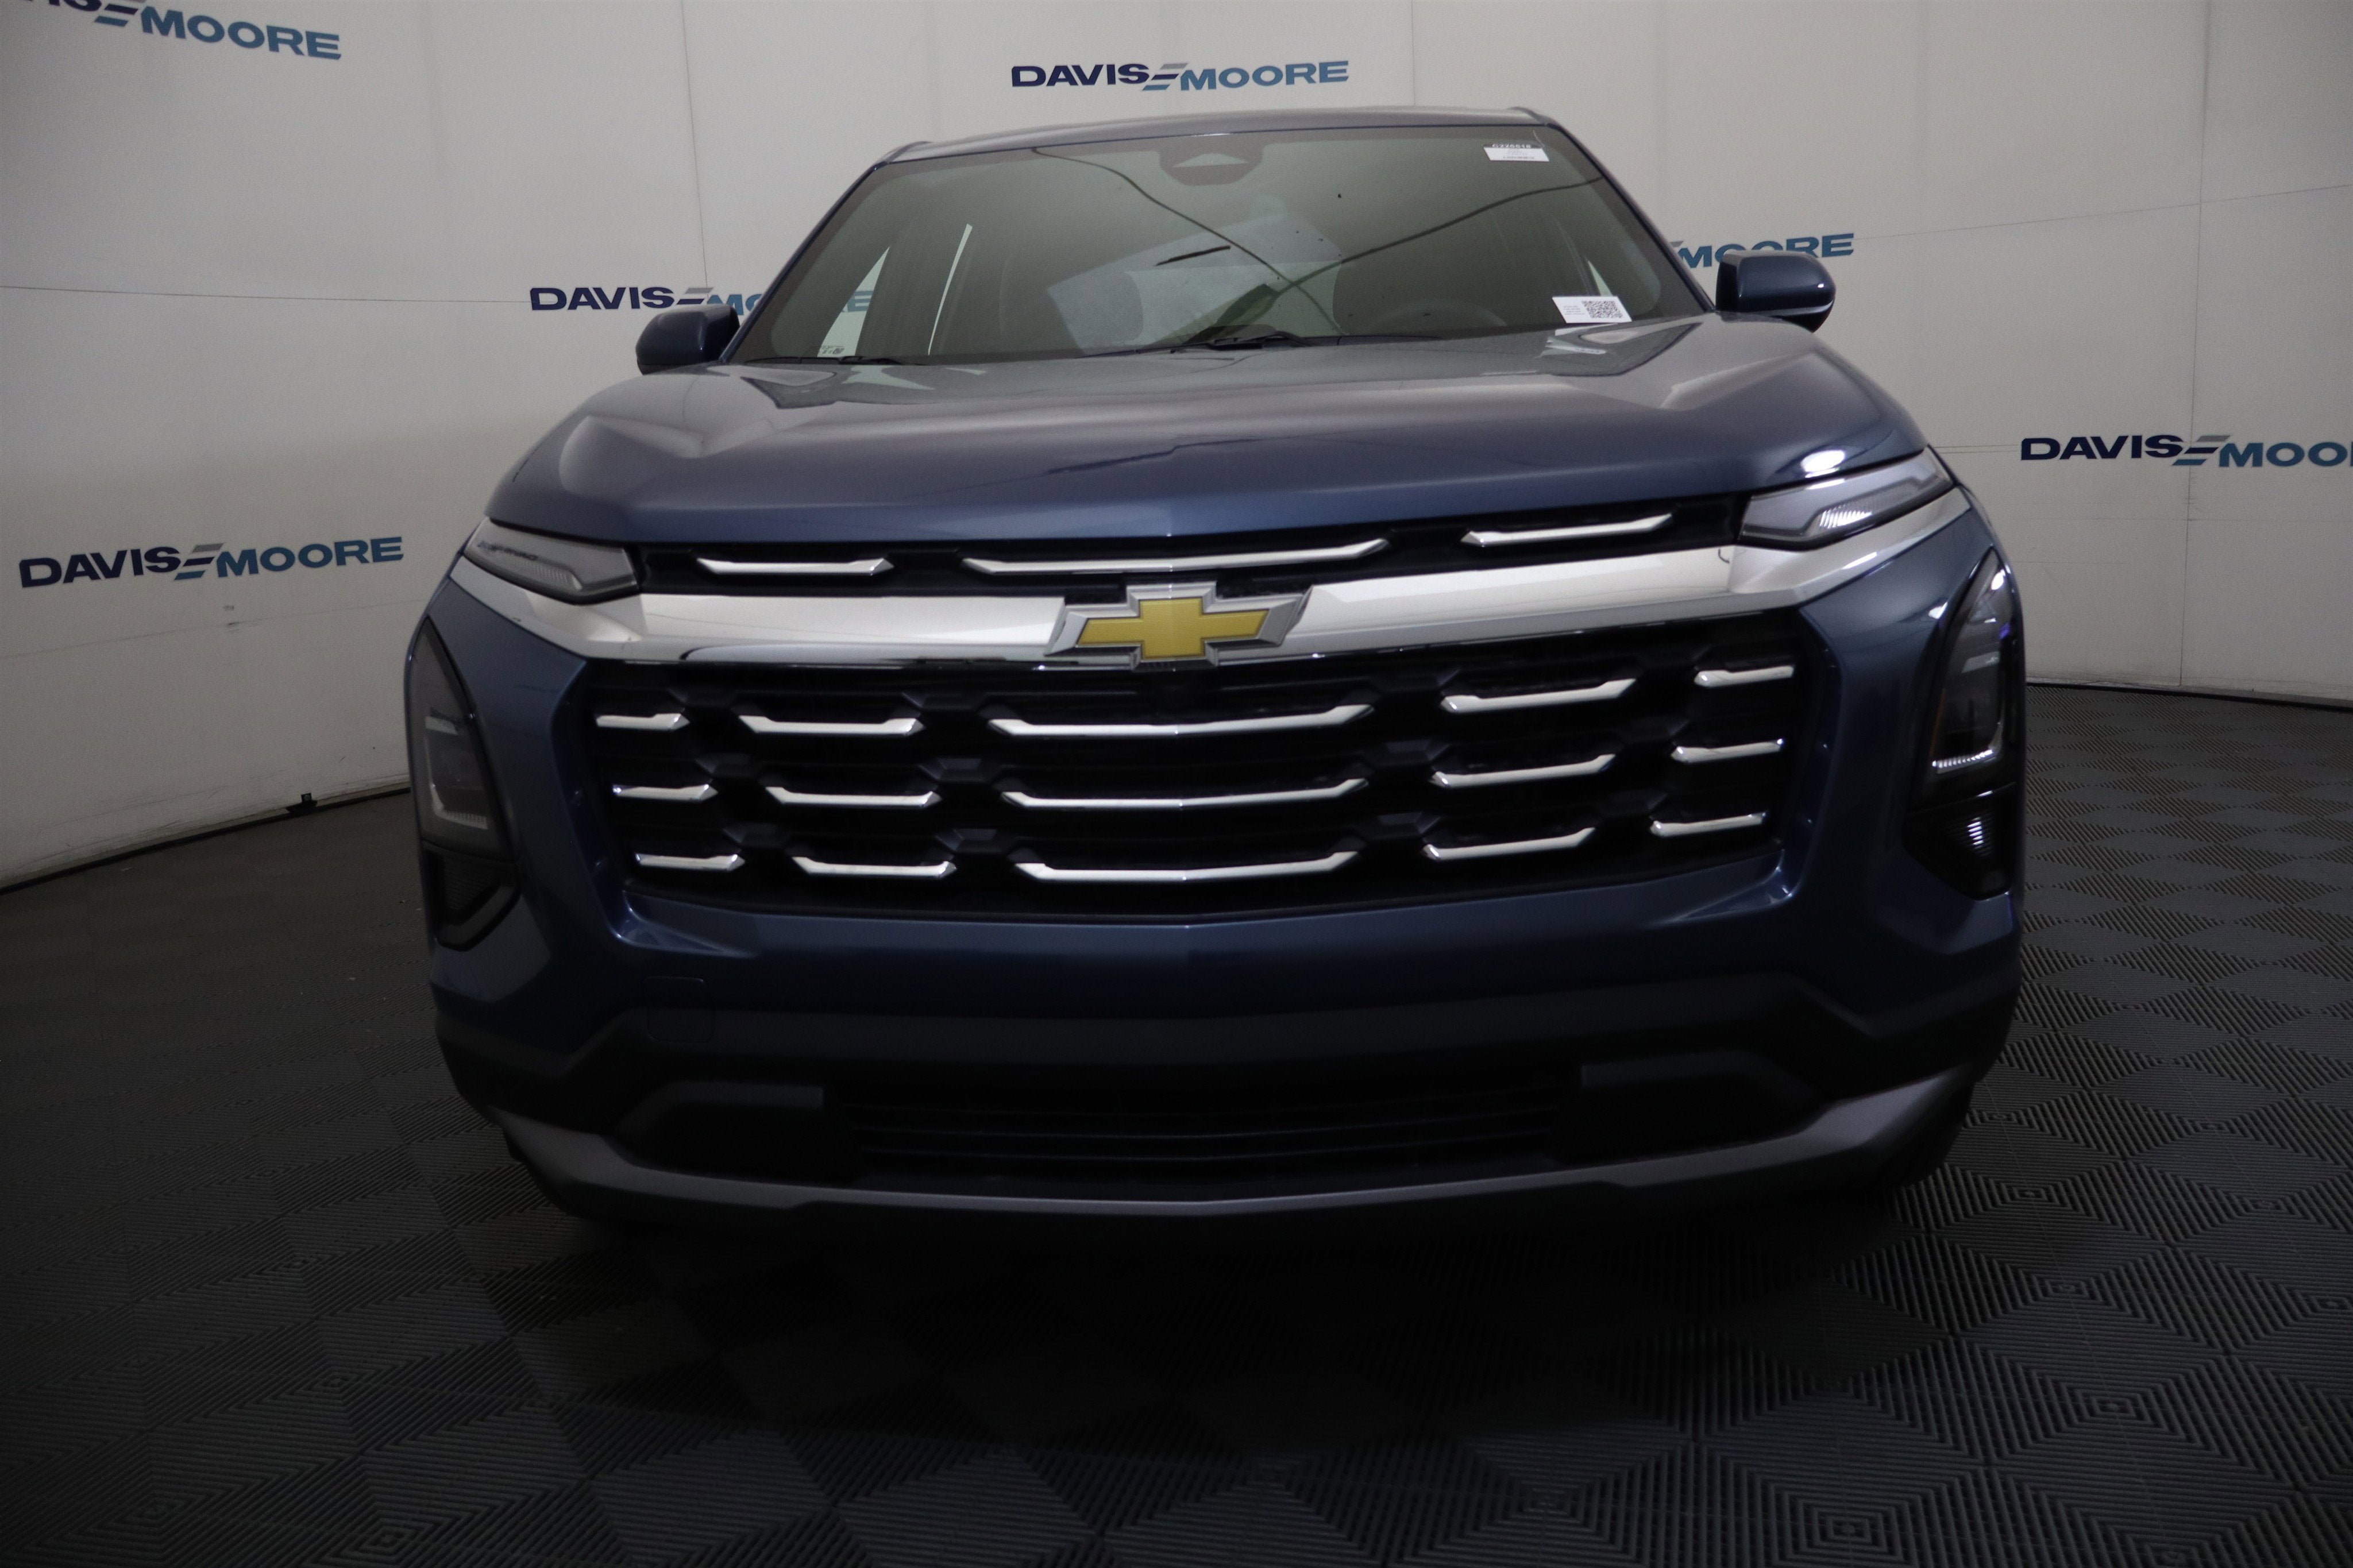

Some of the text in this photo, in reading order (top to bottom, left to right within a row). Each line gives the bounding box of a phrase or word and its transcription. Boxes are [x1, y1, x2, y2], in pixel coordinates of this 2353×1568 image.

[141, 6, 341, 60] MOORE
[1011, 61, 1349, 91] DAVIS MOORE
[530, 287, 674, 311] DAVIS
[2021, 434, 2353, 467] DAVIS MOO
[18, 536, 404, 588] DAVIS MOORE
